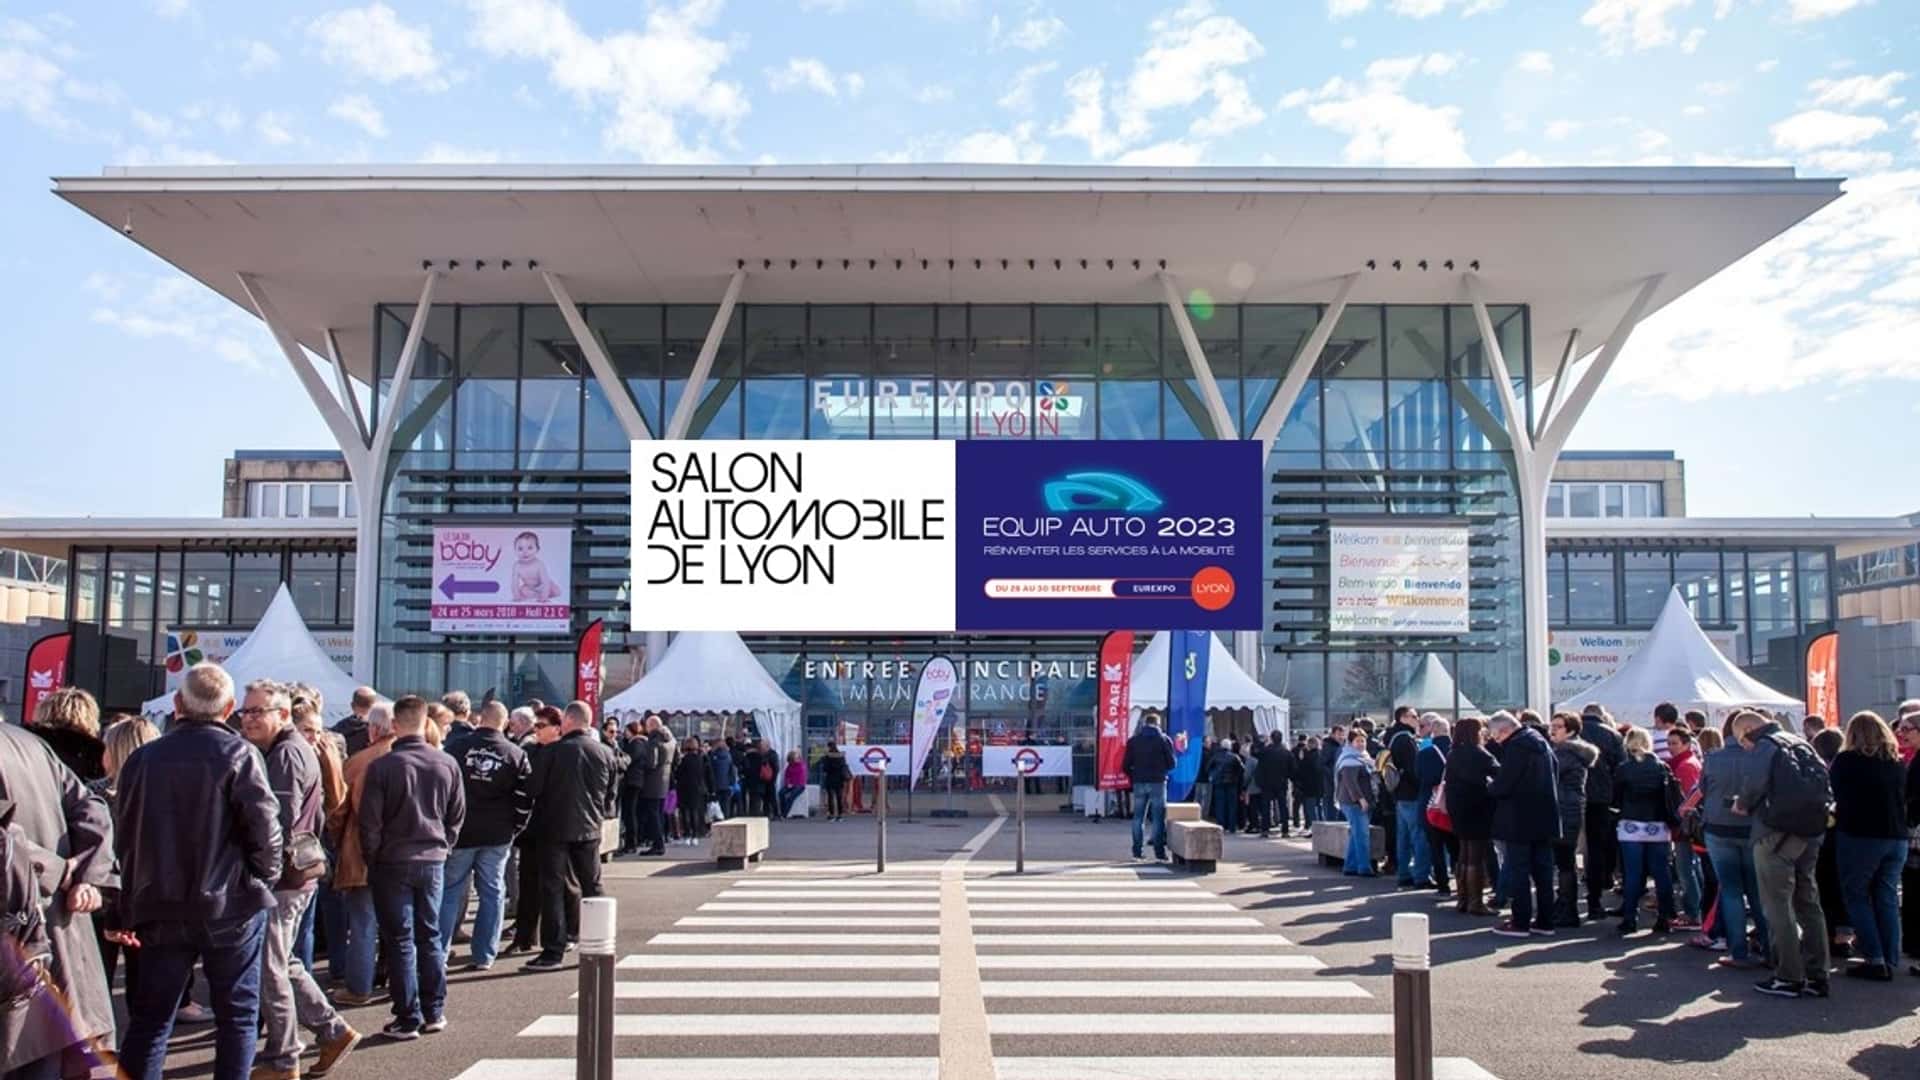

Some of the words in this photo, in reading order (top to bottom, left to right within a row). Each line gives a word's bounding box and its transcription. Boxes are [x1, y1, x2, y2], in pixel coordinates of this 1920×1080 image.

[813, 381, 1027, 409] EUREXPO
[975, 411, 1059, 438] LYON
[440, 540, 501, 573] baby
[1404, 579, 1462, 590] Bienvenido
[1386, 594, 1464, 607] Willkommen
[461, 607, 471, 617] 25
[473, 608, 494, 617] mars
[526, 607, 542, 617] Hall
[558, 607, 565, 617] C
[1335, 613, 1389, 625] Welcome
[1580, 636, 1623, 647] Welkom
[1564, 653, 1618, 663] Bienvenue
[805, 661, 911, 679] ENTREE
[959, 661, 1097, 679] INCIPALE
[850, 684, 911, 700] MAIN
